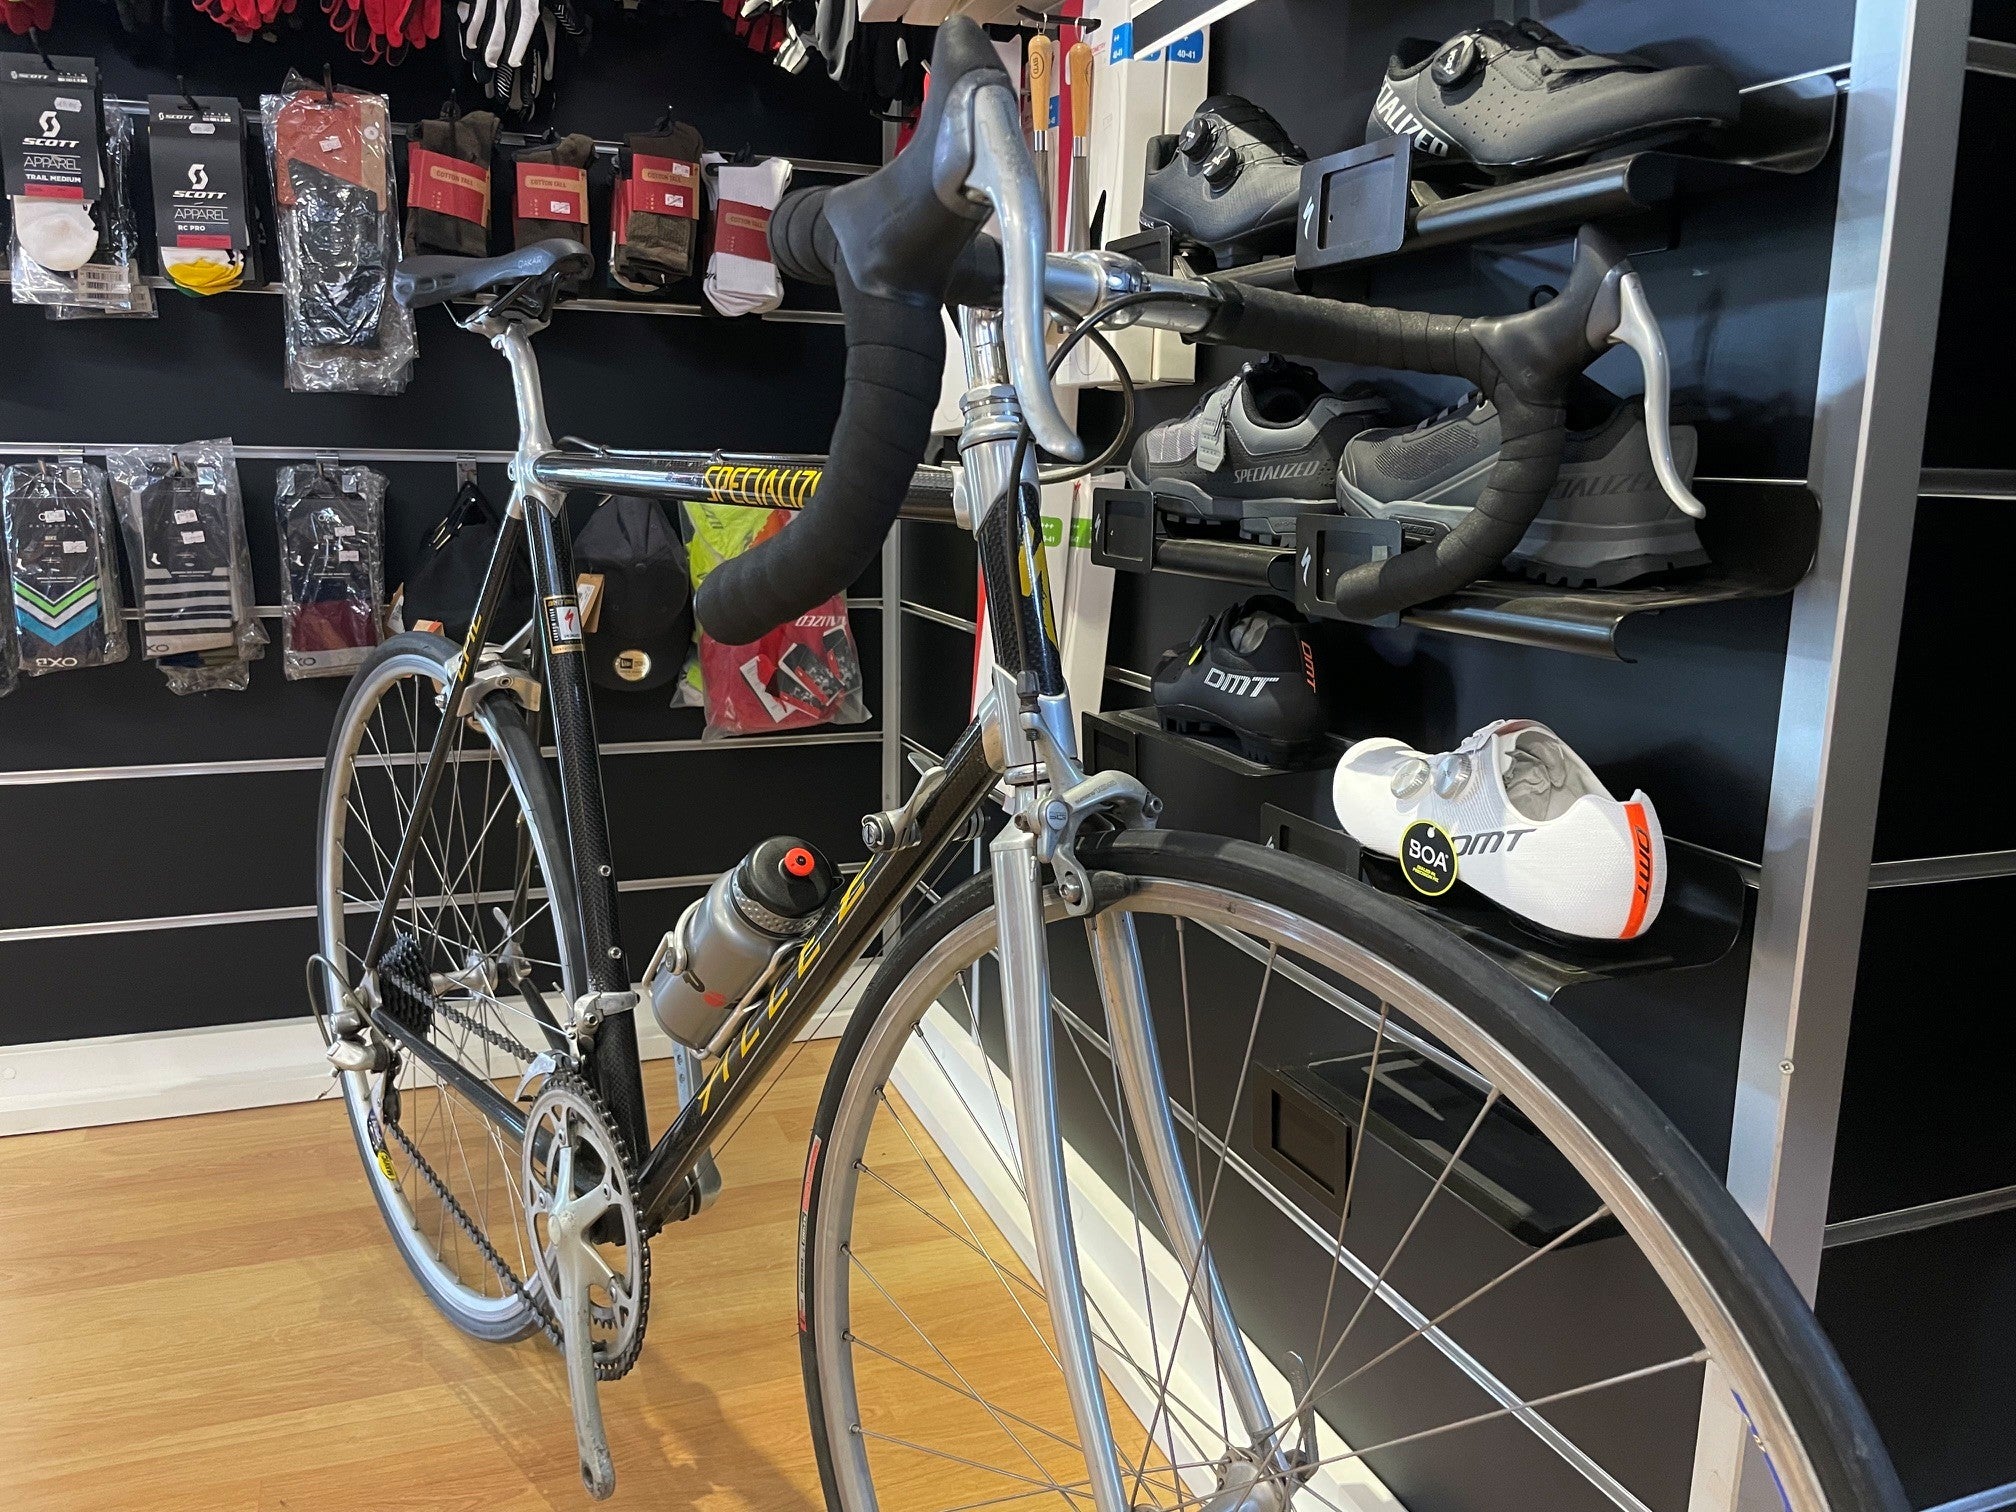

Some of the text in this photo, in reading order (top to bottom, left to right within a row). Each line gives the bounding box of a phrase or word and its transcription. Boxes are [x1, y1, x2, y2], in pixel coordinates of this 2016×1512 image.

[1177, 49, 1196, 59] 40-41
[22, 137, 80, 148] SCOTT
[24, 156, 81, 171] APPAREL
[25, 173, 49, 181] TRAIL
[172, 190, 227, 199] SCOTT
[174, 208, 229, 221] APPAREL
[1233, 460, 1320, 484] SPECIALIZED
[704, 465, 823, 508] SPECIALIZ
[1203, 667, 1280, 698] DMT
[1408, 838, 1448, 873] BOA
[1635, 825, 1651, 904] DMT
